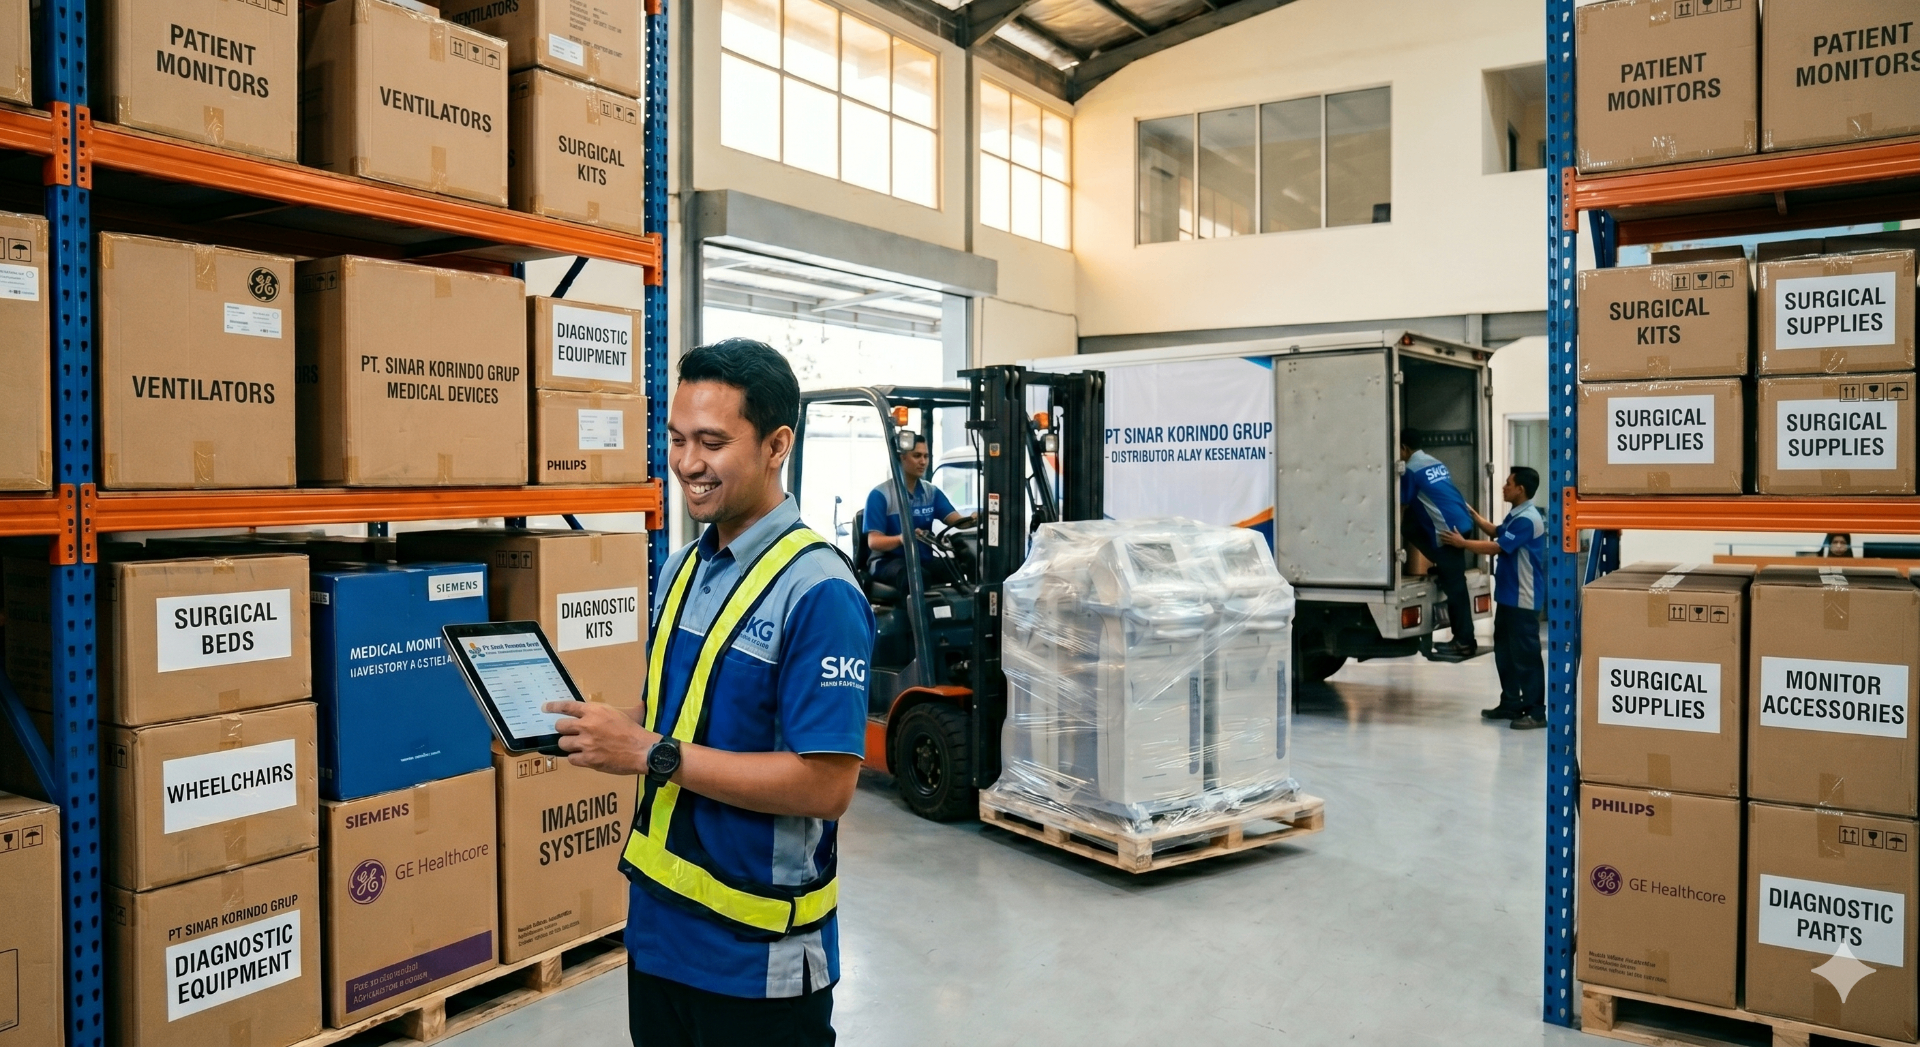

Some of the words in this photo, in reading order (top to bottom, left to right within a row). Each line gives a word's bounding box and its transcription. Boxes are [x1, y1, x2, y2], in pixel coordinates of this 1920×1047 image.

[170, 23, 256, 66] PATIENT
[1813, 21, 1913, 57] PATIENT
[156, 50, 270, 98] MONITORS
[1620, 52, 1707, 83] PATIENT
[1608, 77, 1721, 112] MONITORS
[379, 86, 492, 133] VENTILATORS
[558, 135, 625, 168] SURGICAL
[577, 163, 607, 186] KITS
[1609, 297, 1710, 321] SURGICAL
[1785, 287, 1886, 310] SURGICAL
[557, 322, 628, 346] DIAGNOSTIC
[1637, 325, 1681, 345] KITS
[1786, 312, 1883, 336] SUPPLIES
[558, 345, 627, 367] EQUIPMENT
[361, 355, 380, 374] PT.
[385, 357, 425, 376] SINAR
[429, 360, 484, 380] KORINDO
[487, 364, 520, 383] GRUP
[132, 375, 275, 405] VENTILATORS
[387, 381, 444, 402] MEDICAL
[448, 385, 498, 405] DEVICES
[1615, 407, 1707, 428] SURGICAL
[1786, 411, 1887, 432] SURGICAL
[1105, 428, 1120, 444] PT
[1124, 426, 1163, 444] SINAR
[1167, 424, 1229, 443] KORINDO
[1233, 422, 1273, 440] GRUP
[1617, 432, 1704, 452] SUPPLIES
[1111, 449, 1175, 463] DISTRIBUTOR
[1788, 437, 1884, 457] SUPPLIES
[547, 460, 587, 471] PHILIPS
[436, 580, 478, 593] SIEMENS
[174, 602, 277, 630] SURGICAL
[561, 596, 636, 619] DIAGNOSTIC
[585, 620, 613, 640] KITS
[744, 616, 775, 642] KG
[202, 630, 254, 655] BEDS
[350, 641, 403, 660] MEDICAL
[406, 636, 442, 653] MONIT
[821, 656, 866, 682] SKG
[1610, 668, 1708, 693] SURGICAL
[1786, 670, 1881, 696] MONITOR
[1612, 694, 1705, 720] SUPPLIES
[1762, 694, 1905, 725] ACCESSORIES
[167, 763, 294, 804] WHEELCHAIRS
[345, 803, 410, 829] SIEMENS
[542, 791, 618, 834] IMAGING
[1592, 797, 1655, 817] PHILIPS
[539, 820, 621, 867] SYSTEMS
[395, 861, 414, 880] GE
[1629, 878, 1648, 892] GE
[168, 926, 182, 941] PT
[185, 918, 218, 936] SINAR
[221, 902, 268, 925] KORINDO
[270, 894, 298, 914] GRUP
[1769, 887, 1894, 925] DIAGNOSTIC
[1796, 918, 1863, 947] PARTS
[175, 923, 293, 978] DIAGNOSTIC
[178, 950, 292, 1005] EQUIPMENT
